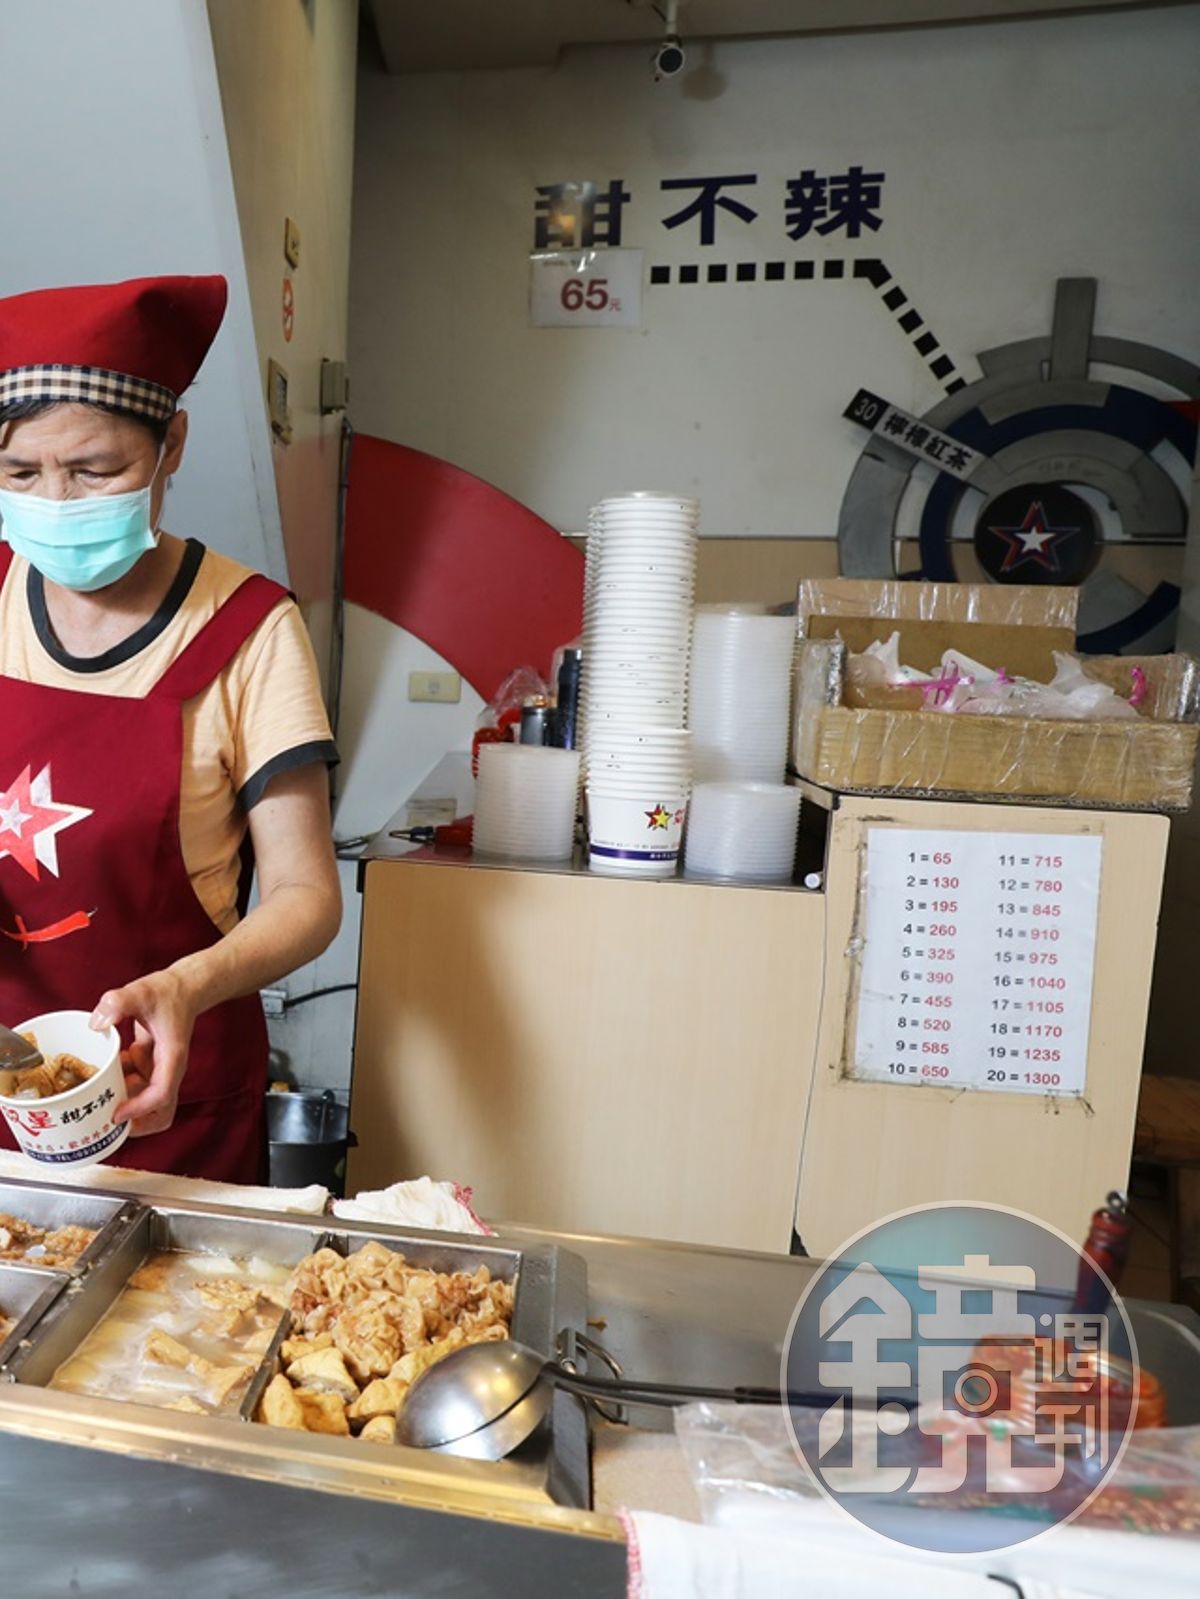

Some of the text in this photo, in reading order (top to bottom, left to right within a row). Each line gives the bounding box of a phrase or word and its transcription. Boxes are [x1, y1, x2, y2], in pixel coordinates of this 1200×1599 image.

[534, 165, 887, 249] 甜不辣
[560, 278, 622, 312] 65元
[853, 397, 879, 422] 30
[882, 411, 973, 472] 檸檬紅茶
[909, 852, 915, 862] 1
[933, 852, 951, 864] 65
[1000, 855, 1014, 866] 11
[1035, 856, 1062, 868] 715
[907, 875, 915, 887] 2
[934, 877, 959, 888] 130
[1000, 879, 1016, 890] 12
[1036, 880, 1062, 892] 780
[906, 900, 914, 911] 3
[932, 901, 958, 912] 195
[998, 903, 1015, 915] 13
[1032, 904, 1060, 916] 845
[904, 924, 912, 934] 4
[930, 924, 956, 936] 260
[996, 928, 1013, 938] 14
[1031, 928, 1059, 941] 910
[902, 946, 911, 958] 5
[928, 948, 955, 960] 325
[995, 952, 1012, 963] 15
[1029, 952, 1058, 965] 975
[901, 970, 909, 981] 6
[927, 972, 953, 984] 390
[994, 976, 1011, 986] 16
[1029, 977, 1066, 990] 1040
[901, 994, 908, 1004] 7
[924, 996, 952, 1007] 455
[992, 999, 1009, 1010] 17
[1028, 1001, 1064, 1014] 1105
[898, 1017, 906, 1028] 8
[924, 1018, 951, 1031] 520
[991, 1023, 1007, 1035] 18
[1026, 1025, 1062, 1038] 1170
[896, 1040, 905, 1051] 9
[922, 1042, 949, 1054] 585
[990, 1047, 1006, 1058] 19
[1024, 1048, 1060, 1061] 1235
[889, 1063, 905, 1074] 10
[922, 1065, 949, 1078] 650
[987, 1070, 1006, 1082] 20
[1024, 1072, 1060, 1086] 1300
